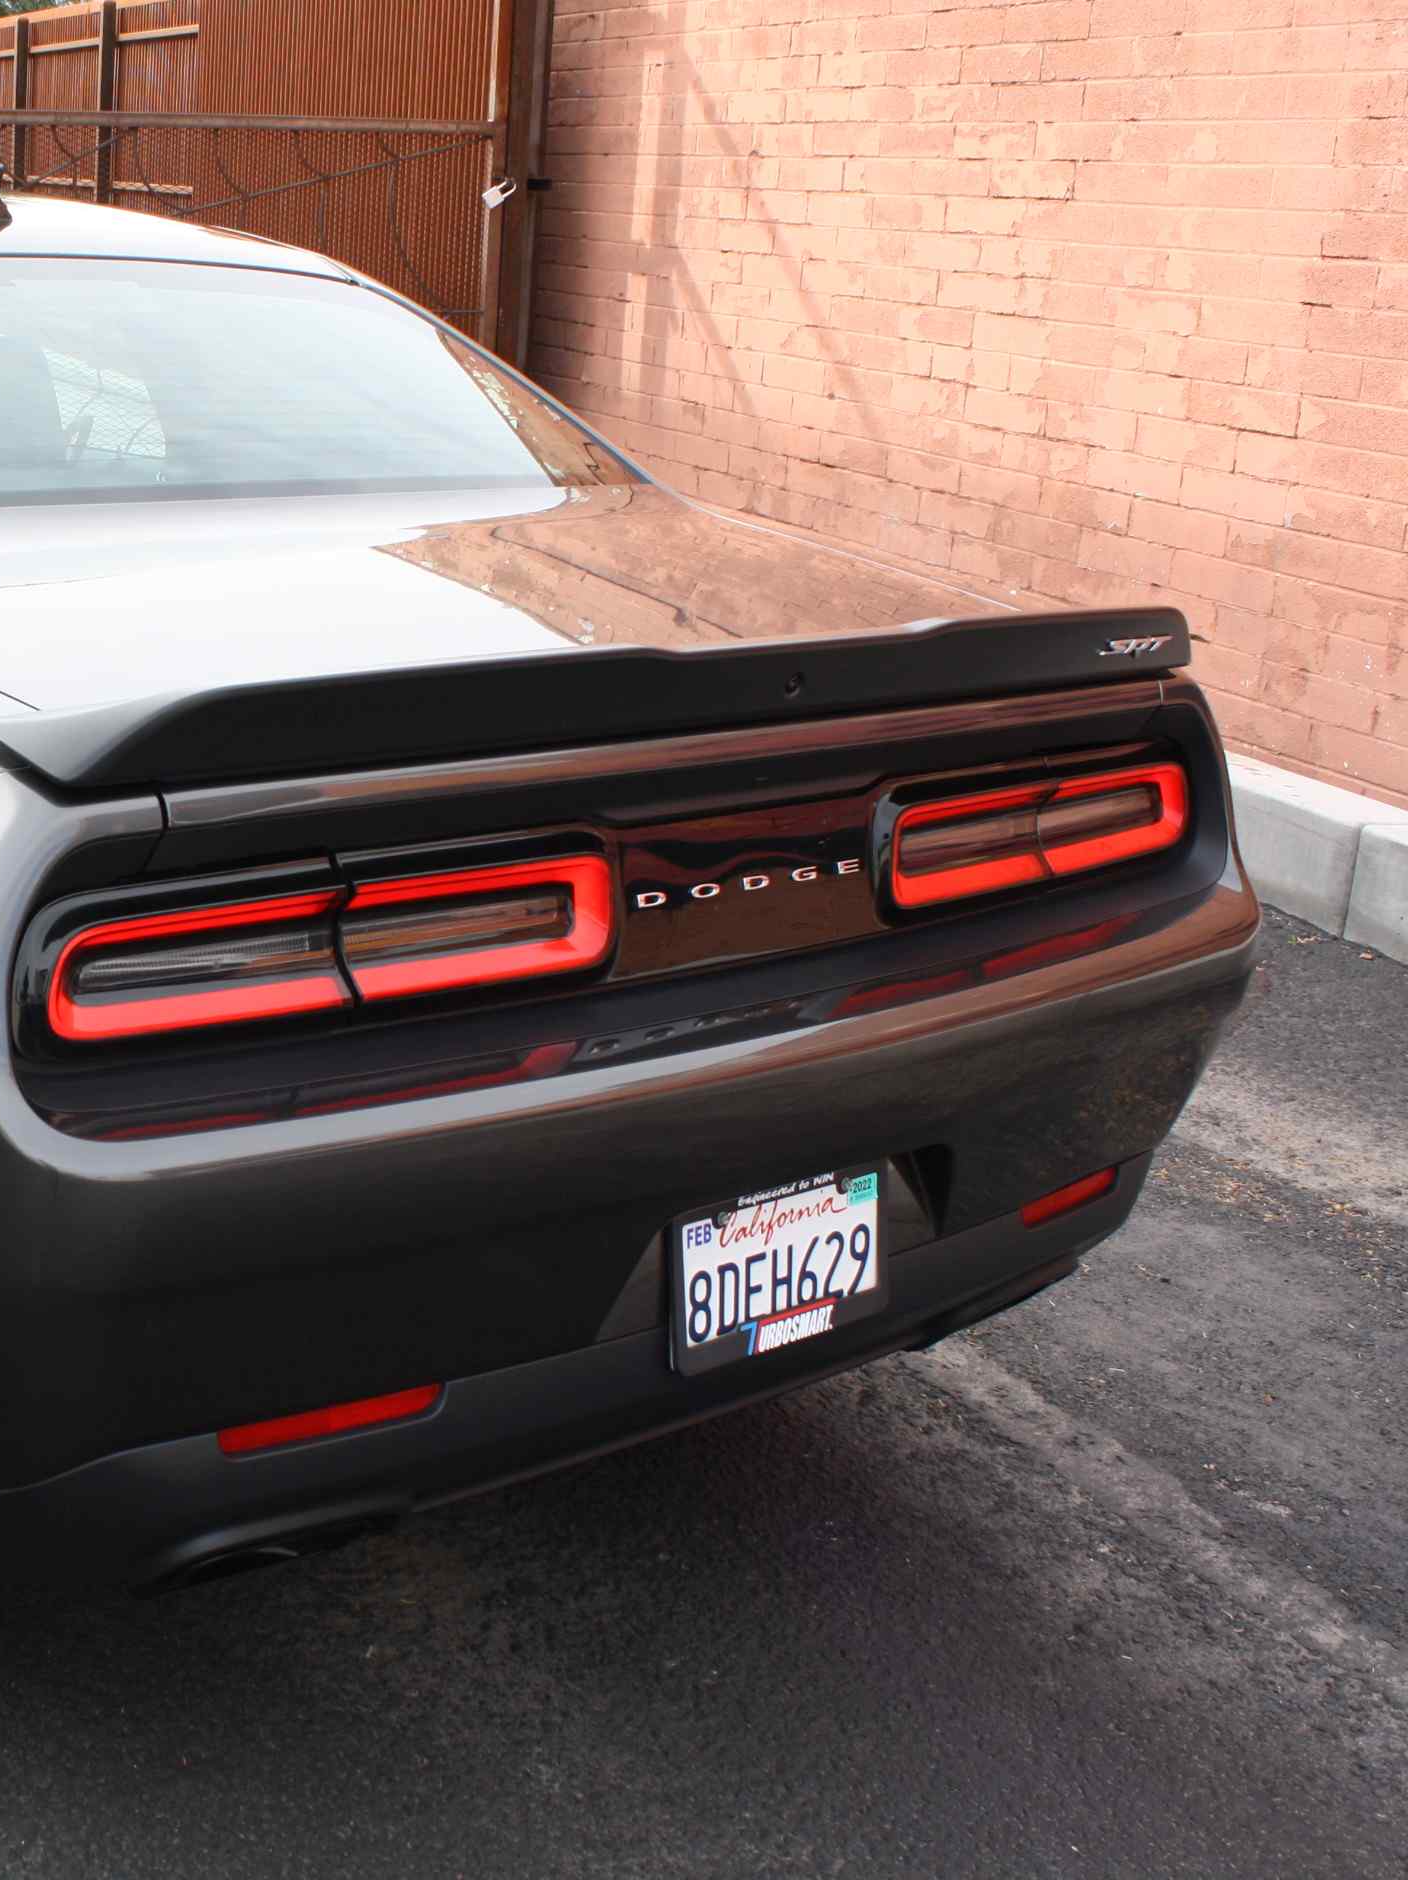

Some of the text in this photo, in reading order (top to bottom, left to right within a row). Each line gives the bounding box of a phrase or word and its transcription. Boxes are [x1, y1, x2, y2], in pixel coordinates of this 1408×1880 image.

[1098, 634, 1174, 656] SRT
[636, 858, 860, 908] DODGE
[799, 1179, 810, 1190] to
[853, 1177, 872, 1194] 2022
[719, 1196, 848, 1248] California
[687, 1223, 712, 1249] FEB
[689, 1223, 870, 1343] 8DEH629
